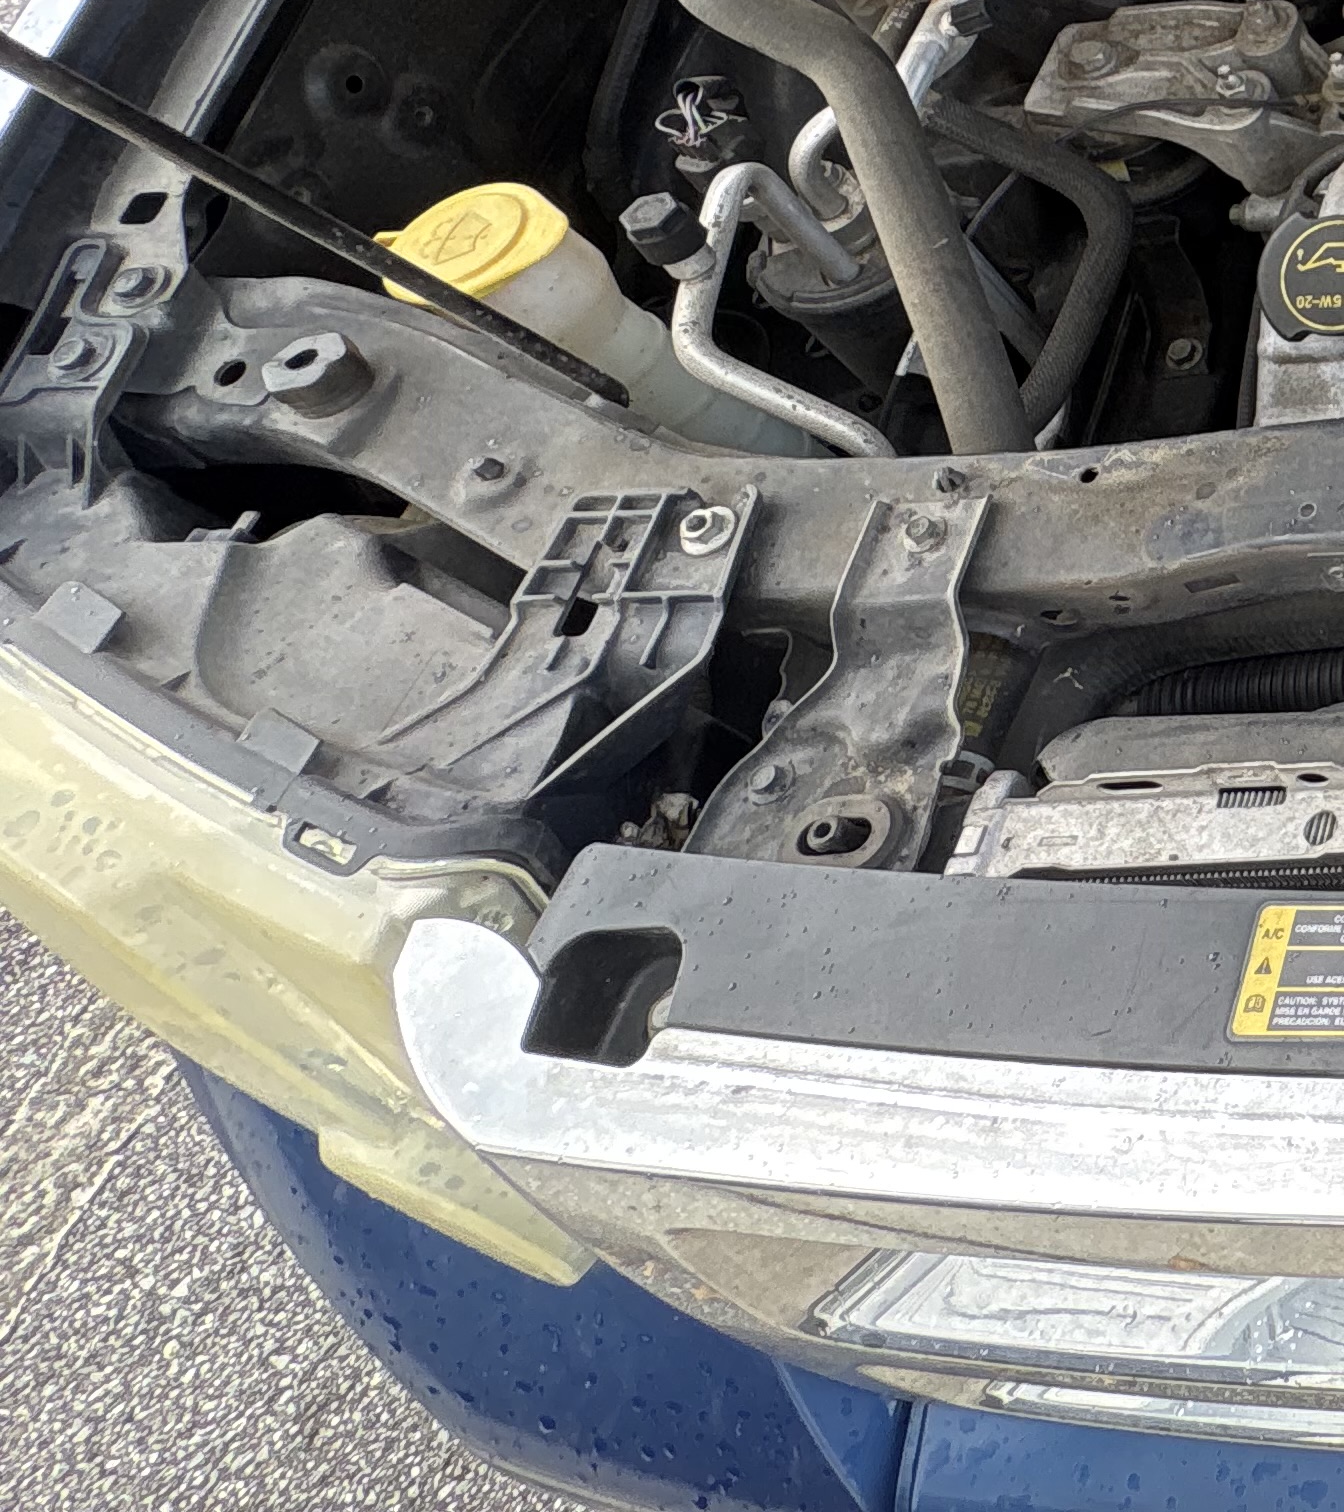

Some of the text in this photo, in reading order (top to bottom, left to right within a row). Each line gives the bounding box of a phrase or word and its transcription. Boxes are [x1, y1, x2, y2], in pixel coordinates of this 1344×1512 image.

[1296, 294, 1343, 309] 5W-20
[1261, 928, 1285, 940] A/C
[1294, 924, 1342, 933] CONFORME
[1277, 996, 1318, 1006] CAUTION:
